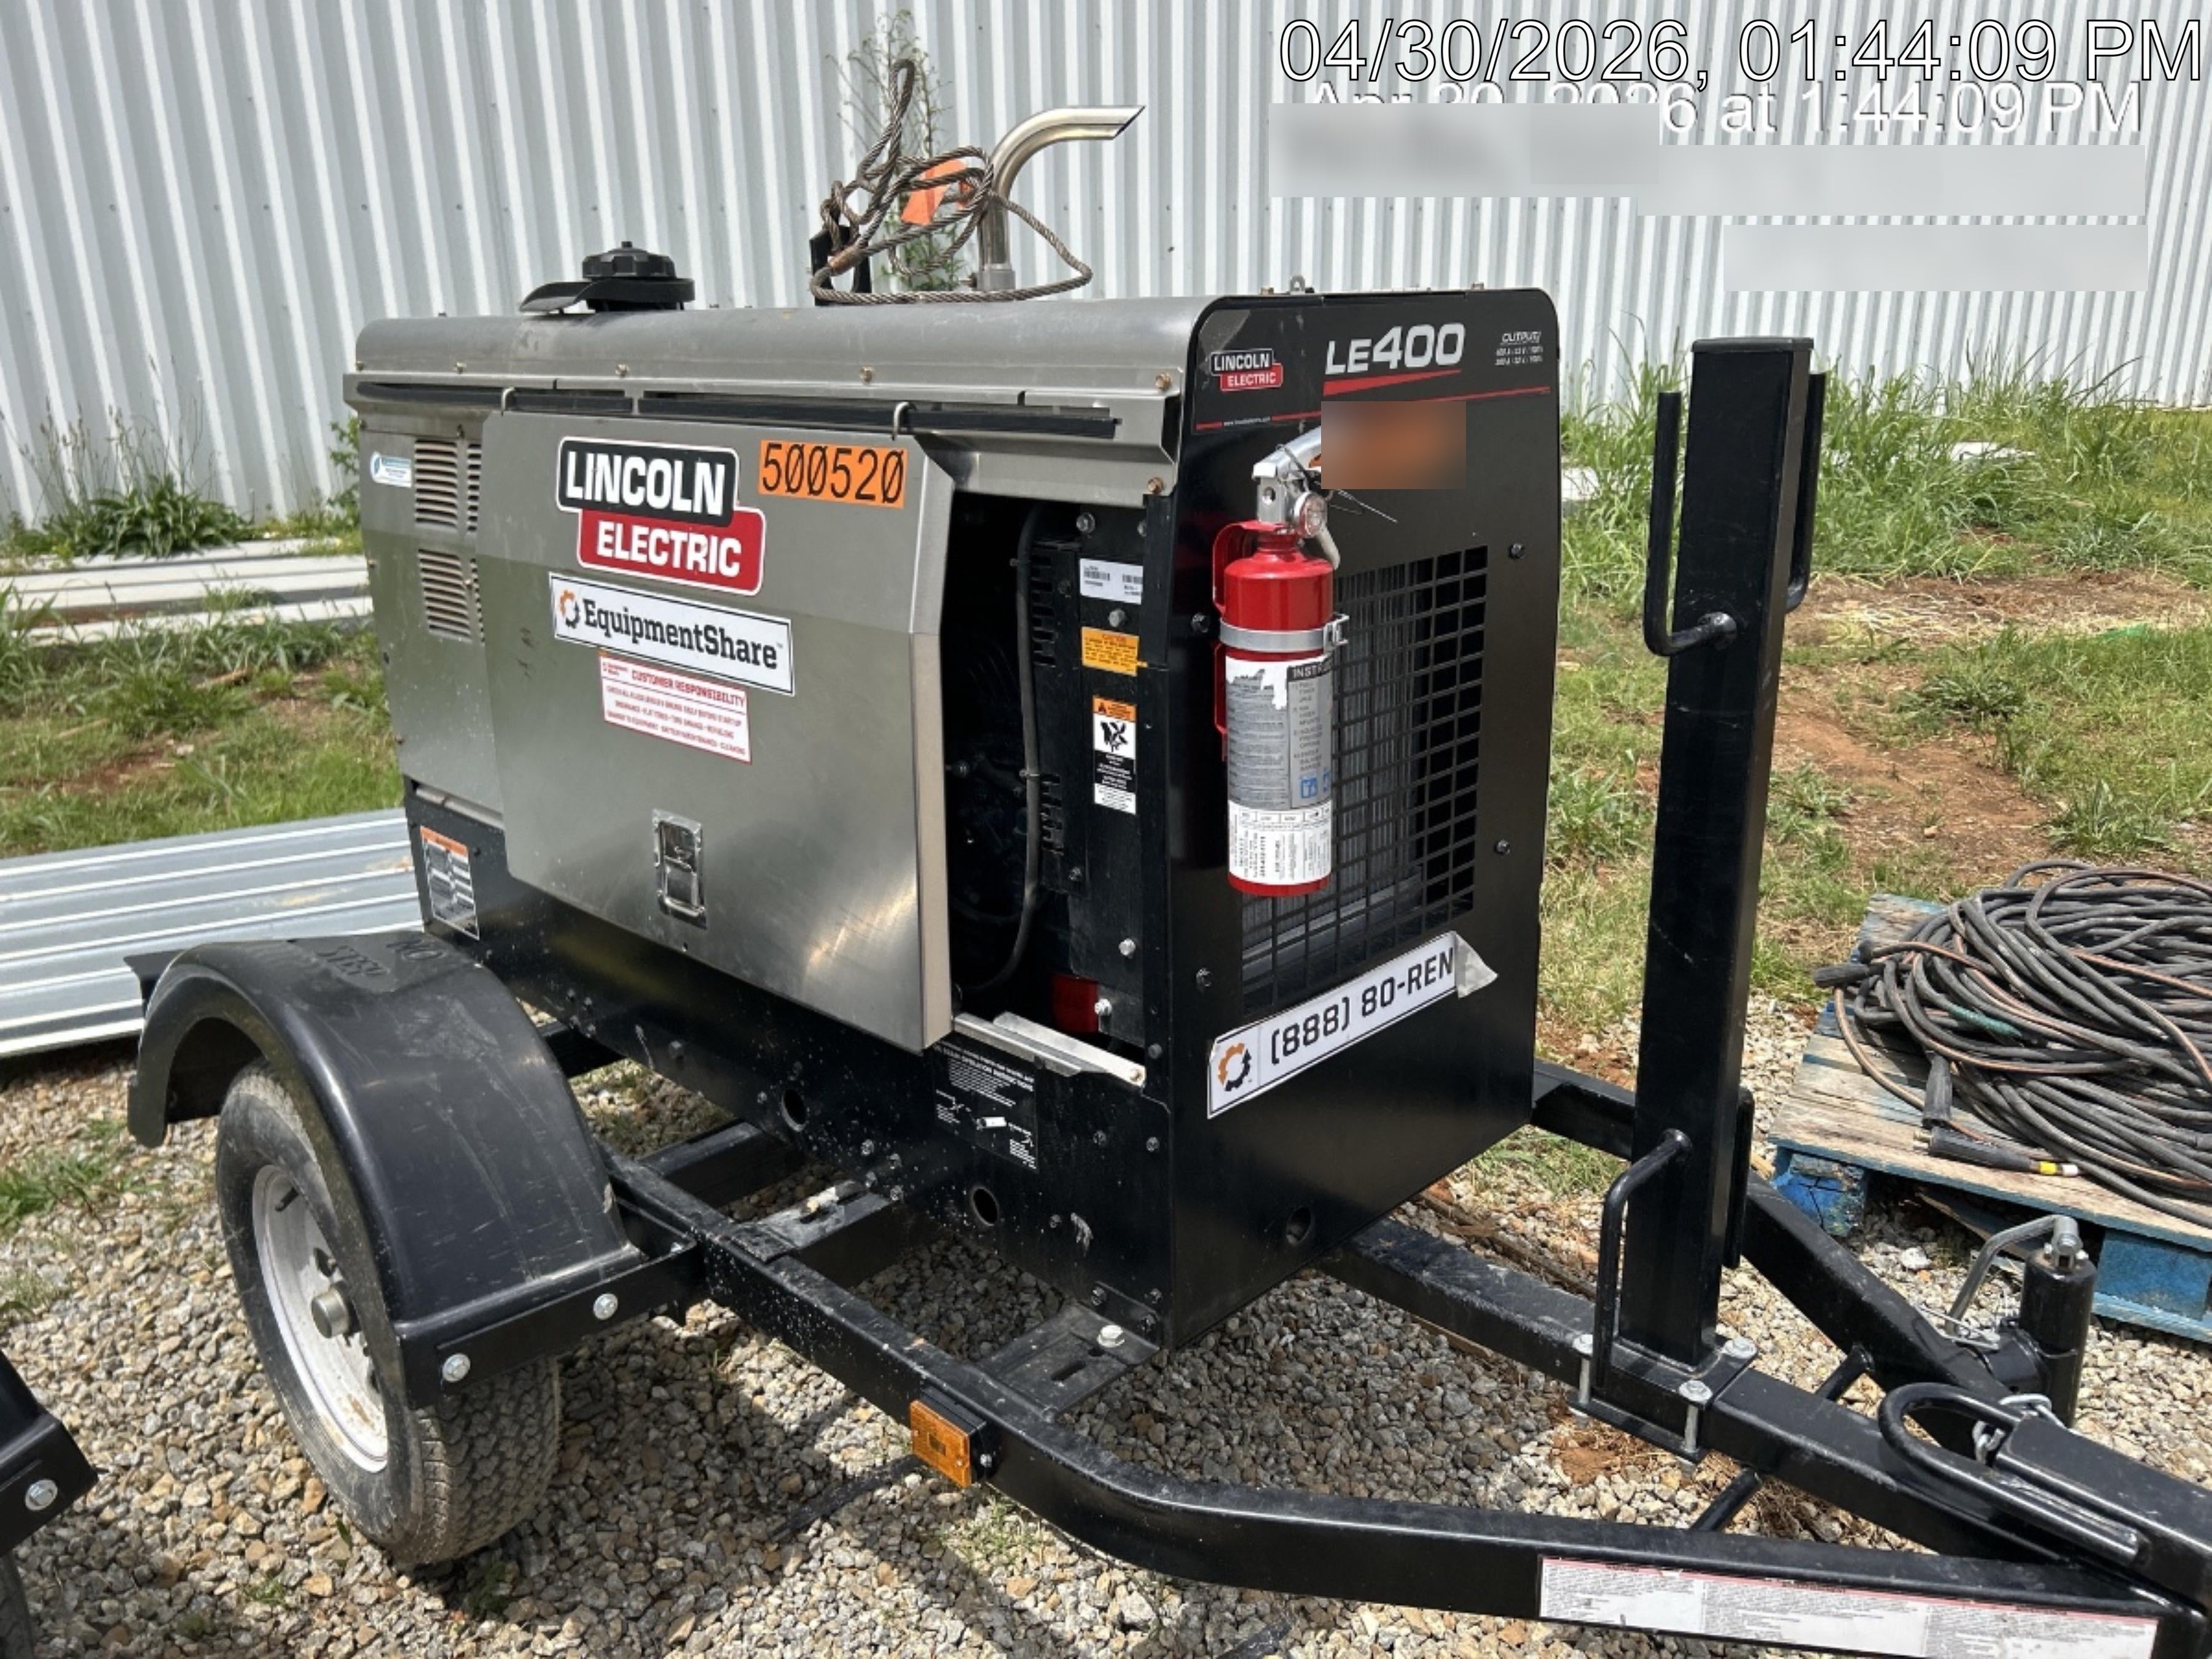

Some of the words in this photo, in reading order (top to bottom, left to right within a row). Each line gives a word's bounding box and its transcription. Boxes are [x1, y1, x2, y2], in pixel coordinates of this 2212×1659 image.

[1214, 352, 1269, 371] LINCOLN
[1325, 323, 1465, 375] LE400
[1227, 371, 1277, 388] ELECTRIC
[565, 450, 726, 517] LINCOLN
[761, 442, 905, 504] 500520
[596, 520, 742, 578] ELECTRIC
[582, 599, 778, 670] EquipmentShare
[1271, 995, 1350, 1065] (888)
